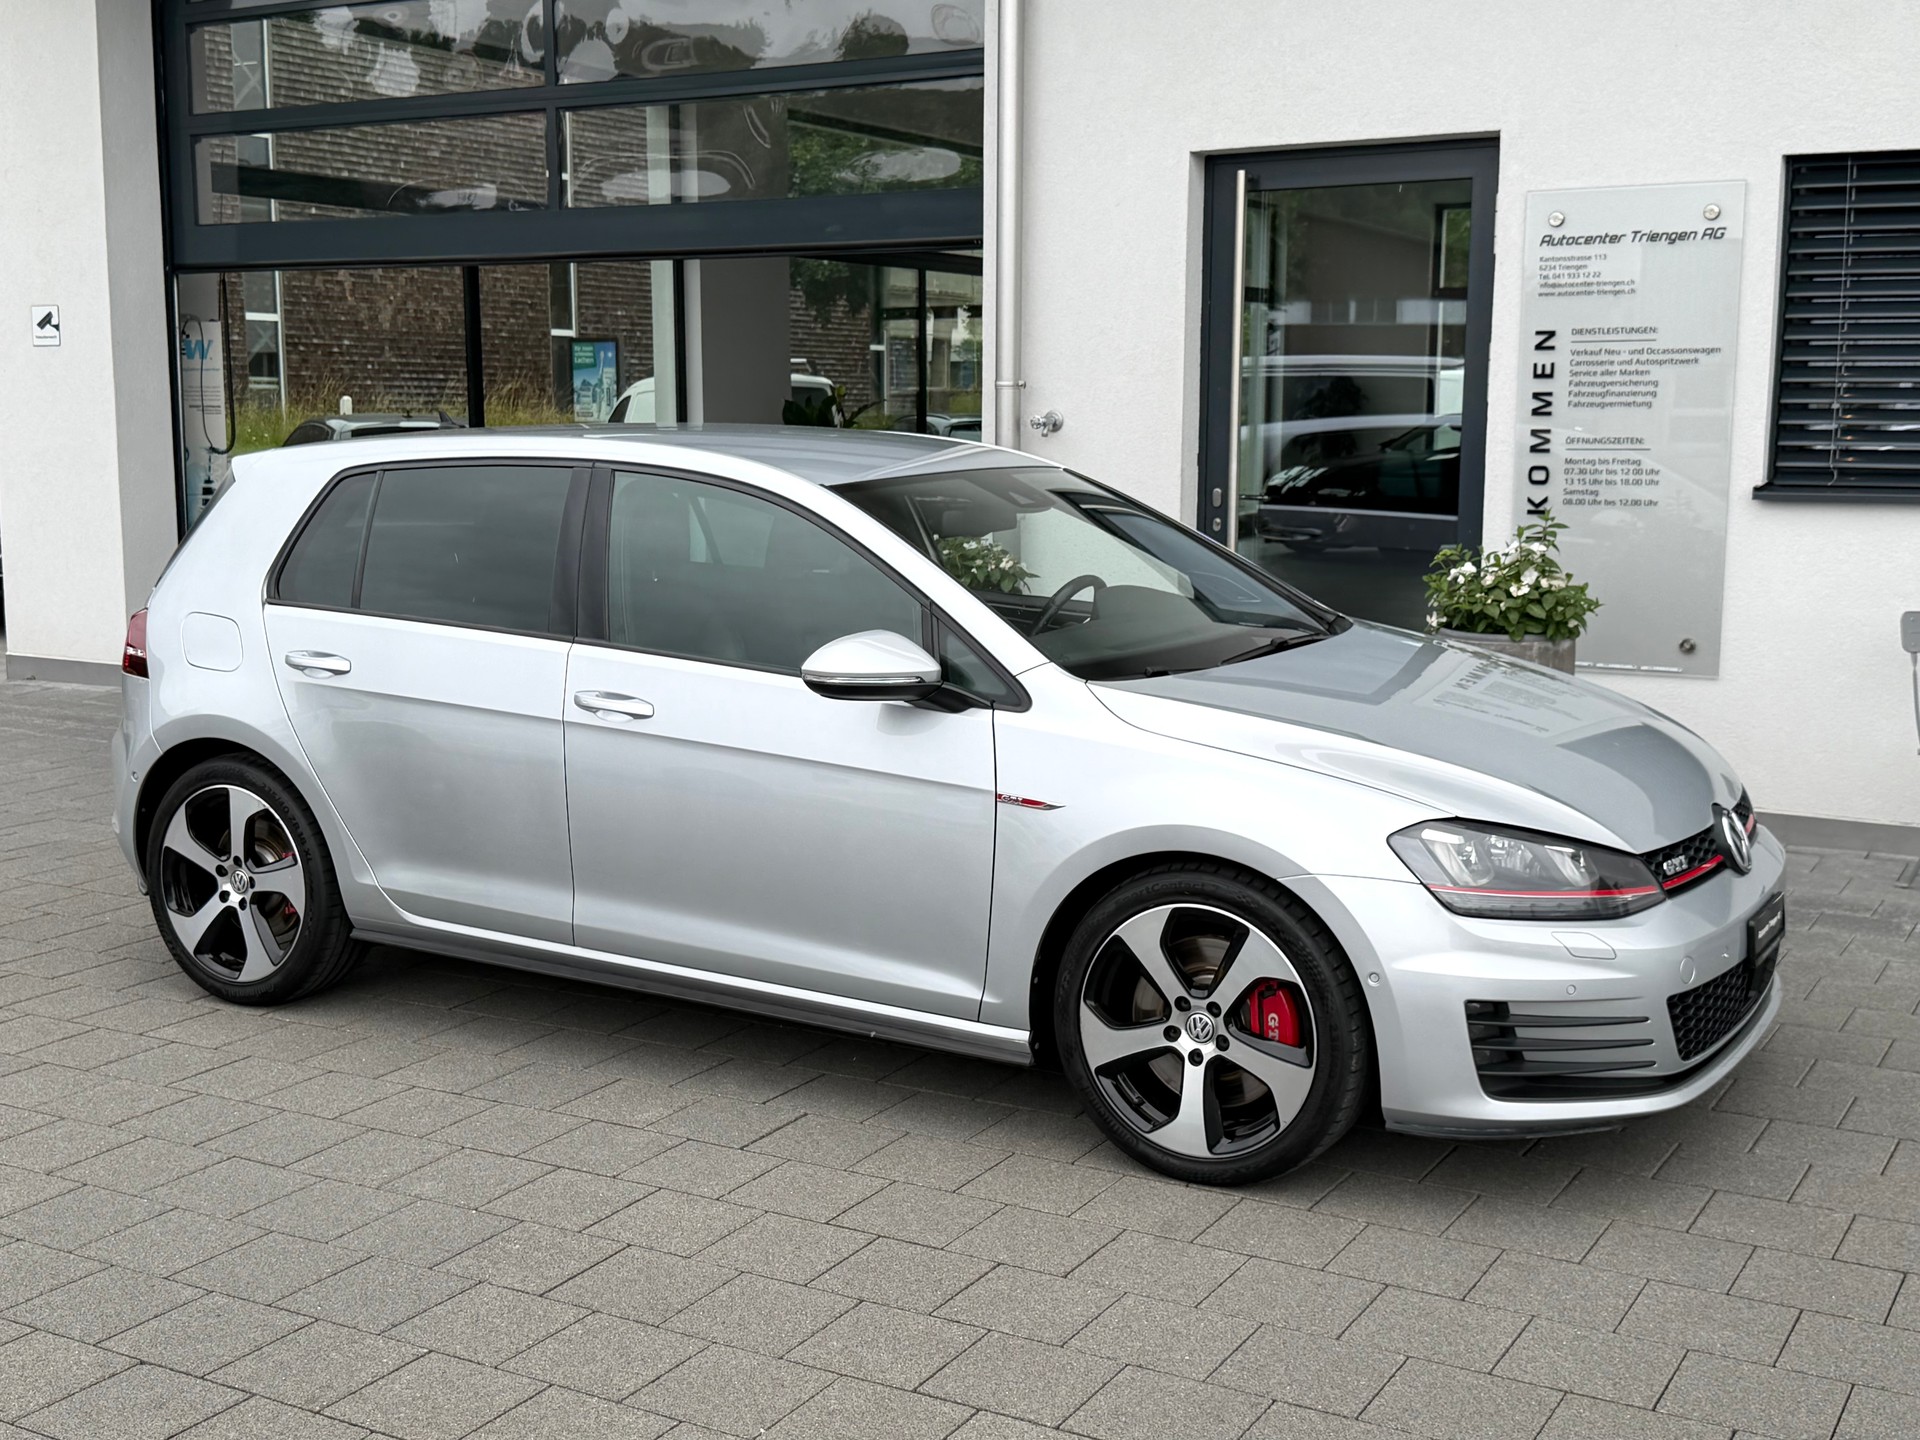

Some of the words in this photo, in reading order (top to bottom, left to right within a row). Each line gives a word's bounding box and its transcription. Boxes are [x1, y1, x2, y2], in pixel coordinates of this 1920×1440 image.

[1539, 232, 1627, 248] Autocenter
[1630, 229, 1698, 244] Triengen
[1700, 227, 1727, 241] AG
[1539, 254, 1593, 263] Kantonsstrasse
[1594, 253, 1608, 261] 113
[1558, 263, 1588, 272] Triengen
[1538, 288, 1636, 298] www.autocenter-triengen.ch
[1571, 326, 1659, 336] DIENSTLEISTUNGEN:
[1570, 349, 1603, 357] Verkauf
[1604, 348, 1621, 356] Neu
[1628, 347, 1645, 356] und
[1646, 346, 1722, 357] Occassionswagen
[1569, 358, 1615, 367] Carrosserie
[1616, 358, 1633, 367] und
[1635, 356, 1700, 368] Autospritzwerk
[1569, 369, 1598, 378] Service
[1599, 368, 1618, 377] aller
[1619, 368, 1651, 377] Marken
[1568, 379, 1659, 389] Fahrzeugversicherung
[1568, 389, 1658, 400] Fahrzeugfinanzierung
[1567, 400, 1653, 410] Fahrzeugvermietung
[1565, 436, 1645, 445] ÖFFNUNGSZEITEN:
[1564, 457, 1597, 467] Montag
[1597, 457, 1610, 466] bis
[1611, 457, 1642, 467] Freitag
[1563, 468, 1588, 476] 07.30
[1588, 468, 1604, 476] Uhr
[1605, 468, 1618, 476] bis
[1645, 468, 1661, 476] Uhr
[1588, 478, 1604, 486] Uhr
[1604, 478, 1617, 486] bis
[1620, 478, 1643, 486] 18.00
[1644, 478, 1660, 486] Uhr
[1562, 488, 1599, 498] Samstag
[1562, 498, 1586, 506] 08.00
[1587, 498, 1602, 506] Uhr
[1604, 498, 1617, 507] bis
[1618, 498, 1642, 507] 12.00
[1643, 499, 1659, 507] Uhr
[1663, 855, 1688, 876] GTI
